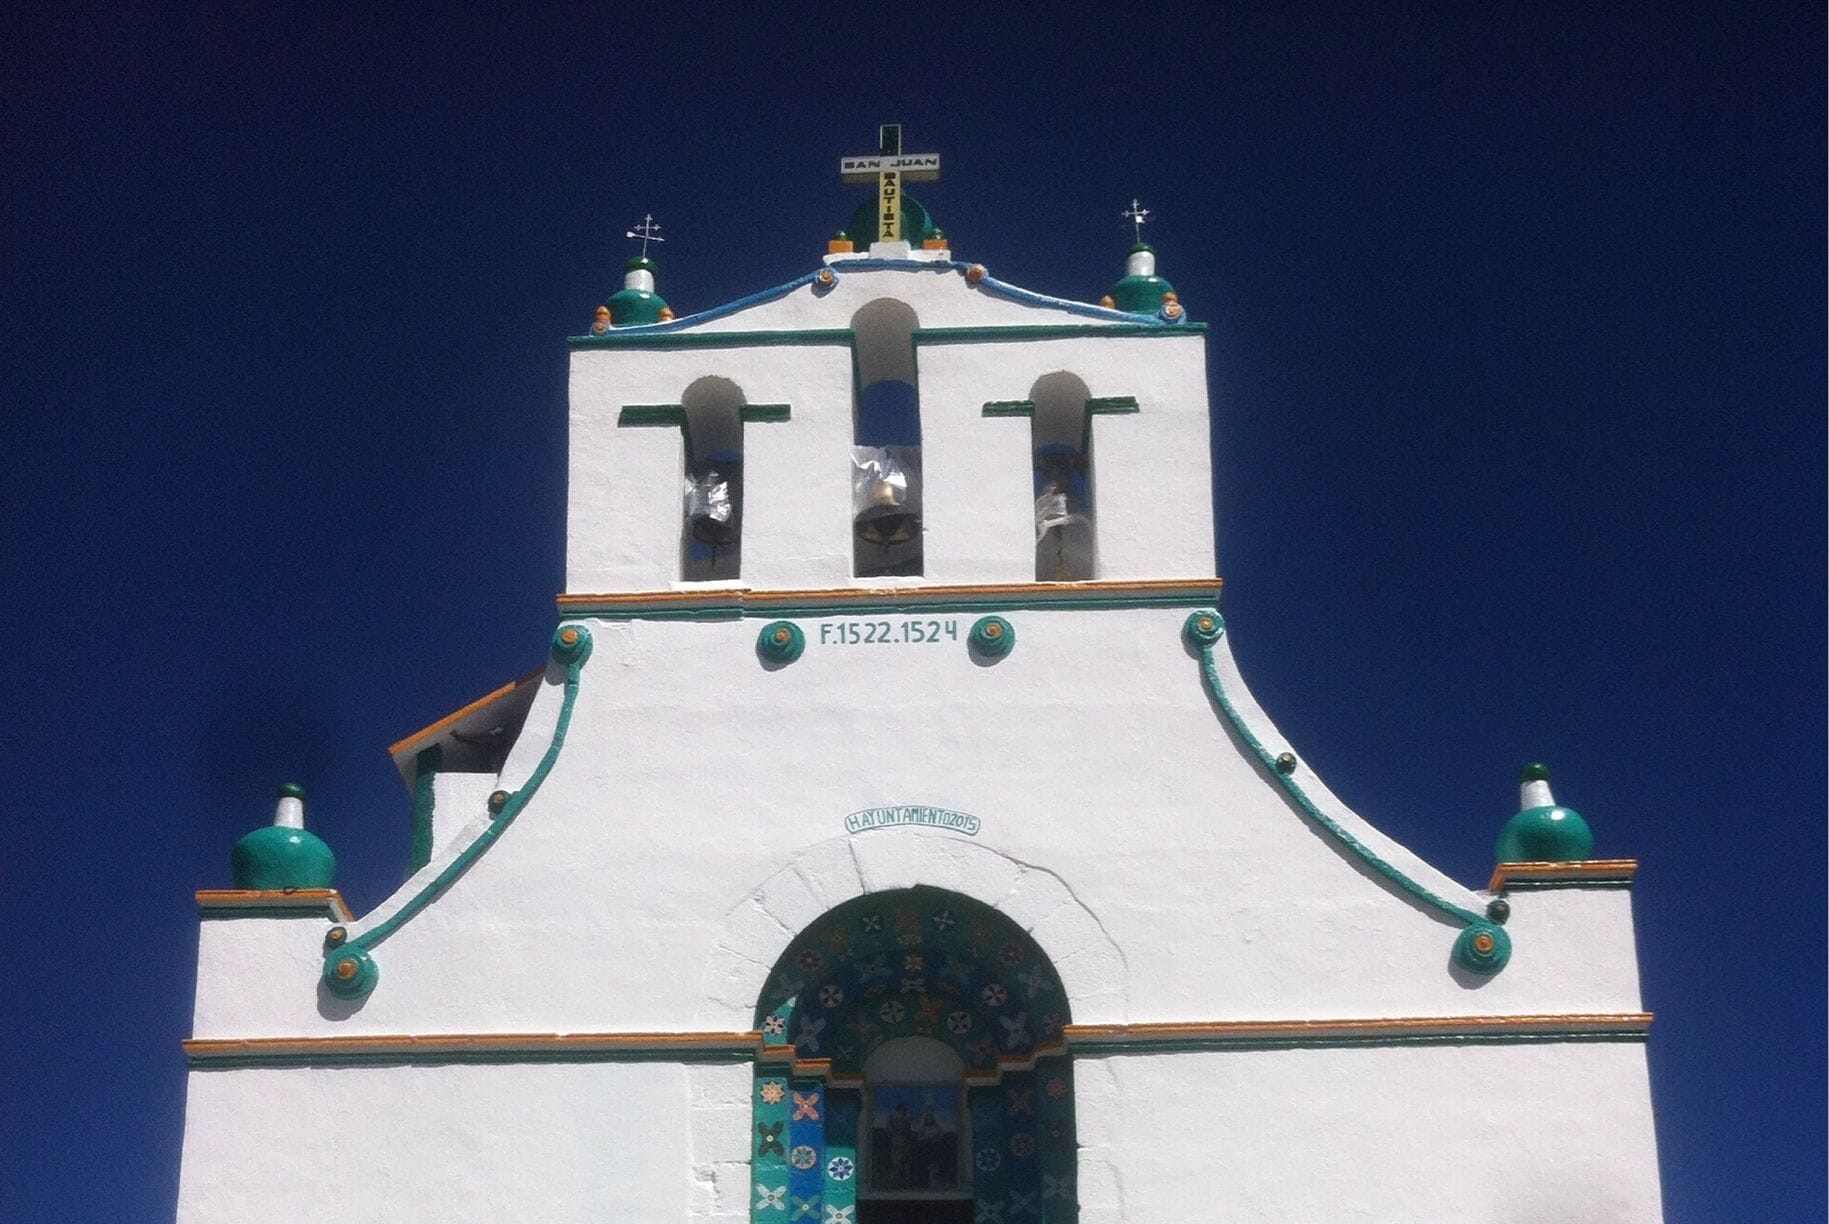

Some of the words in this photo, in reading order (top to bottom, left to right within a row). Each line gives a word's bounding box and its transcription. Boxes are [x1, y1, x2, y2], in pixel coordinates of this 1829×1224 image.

[844, 160, 880, 169] SAN
[890, 158, 937, 167] JUAN
[882, 172, 896, 238] BAUTISTA
[820, 620, 957, 645] F.1522.1524
